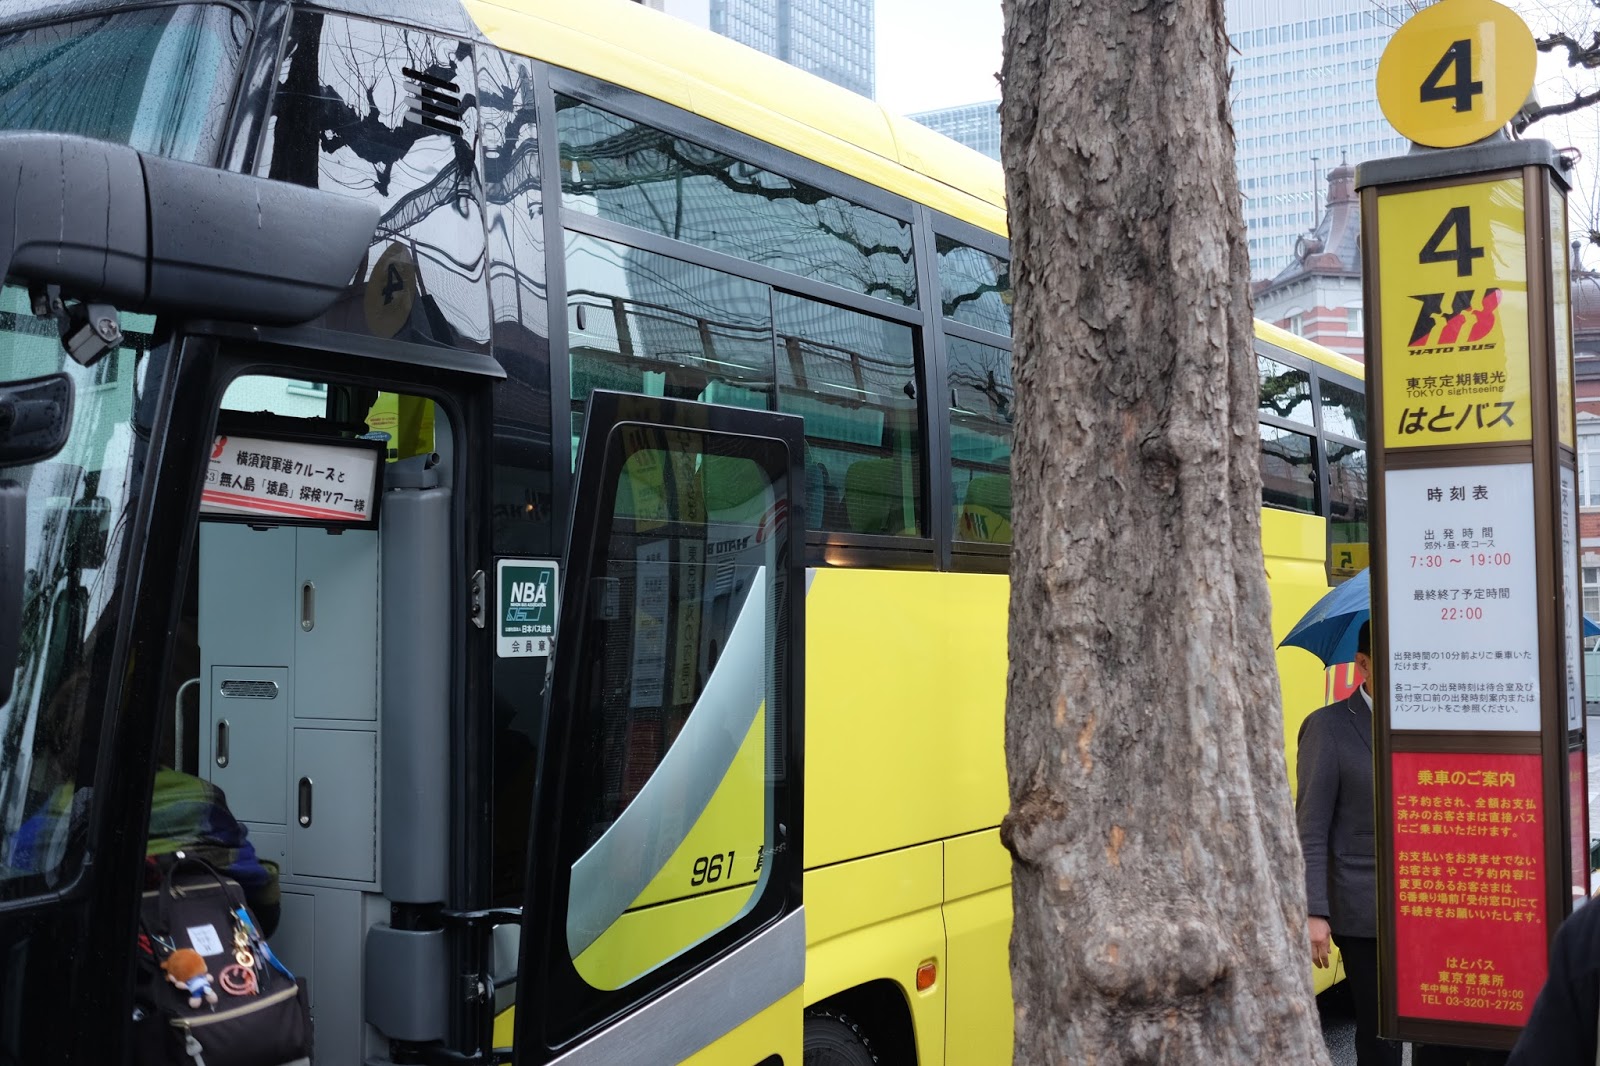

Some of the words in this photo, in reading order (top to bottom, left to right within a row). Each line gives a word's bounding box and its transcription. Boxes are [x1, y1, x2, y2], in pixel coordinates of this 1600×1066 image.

[1420, 39, 1483, 113] 4
[1419, 206, 1484, 277] 4
[1408, 346, 1454, 356] HATO
[1458, 342, 1497, 352] BUS
[1406, 370, 1506, 390] 東京定期観光
[1407, 388, 1443, 398] TOKYO
[1448, 384, 1505, 396] sightseeing
[1398, 401, 1515, 434] はとバス
[236, 450, 346, 484] 横須賀軍港クルーズと
[1427, 484, 1489, 502] 時刻表
[1424, 527, 1494, 541] 出発時間
[1424, 539, 1496, 550] 郊外・昼・夜コース
[1410, 555, 1442, 568] 7:30
[1470, 552, 1512, 567] 19:00
[510, 582, 547, 603] NBA
[1413, 588, 1510, 601] 最終終了予定時間
[1441, 607, 1483, 620] 22:00
[512, 640, 546, 653] 会員章
[1394, 650, 1532, 661] 出発時間の10分前よりご乗車いた
[1394, 662, 1432, 671] だけます。
[1394, 682, 1534, 692] 各コースの出発時刻は待合室及び
[1394, 693, 1535, 703] 受付窓口前の出発時刻案内または
[1417, 769, 1516, 788] 乗車のご案内
[1397, 795, 1537, 810] ご予約をされ、全額お支払
[1397, 809, 1537, 824] 済みのお客さまは直接バス
[1397, 823, 1518, 838] にご乗車いただけます。
[1398, 850, 1537, 867] お支払いをお済ませでない
[690, 850, 736, 887] 961
[1398, 864, 1441, 877] お客さま
[1446, 866, 1458, 877] や
[1462, 866, 1537, 880] ご予約内容に
[1399, 878, 1518, 894] 変更のあるお客さまは、
[1399, 891, 1538, 909] 6番乗り場前「受付窓口」にて
[1399, 905, 1541, 923] 手続きをお願いいたします。
[1446, 957, 1496, 971] はとバス
[1438, 971, 1505, 987] 東京営業所
[1420, 983, 1459, 995] 年中無休
[1421, 994, 1442, 1005] TEL
[1445, 996, 1524, 1011] 03-3201-2725
